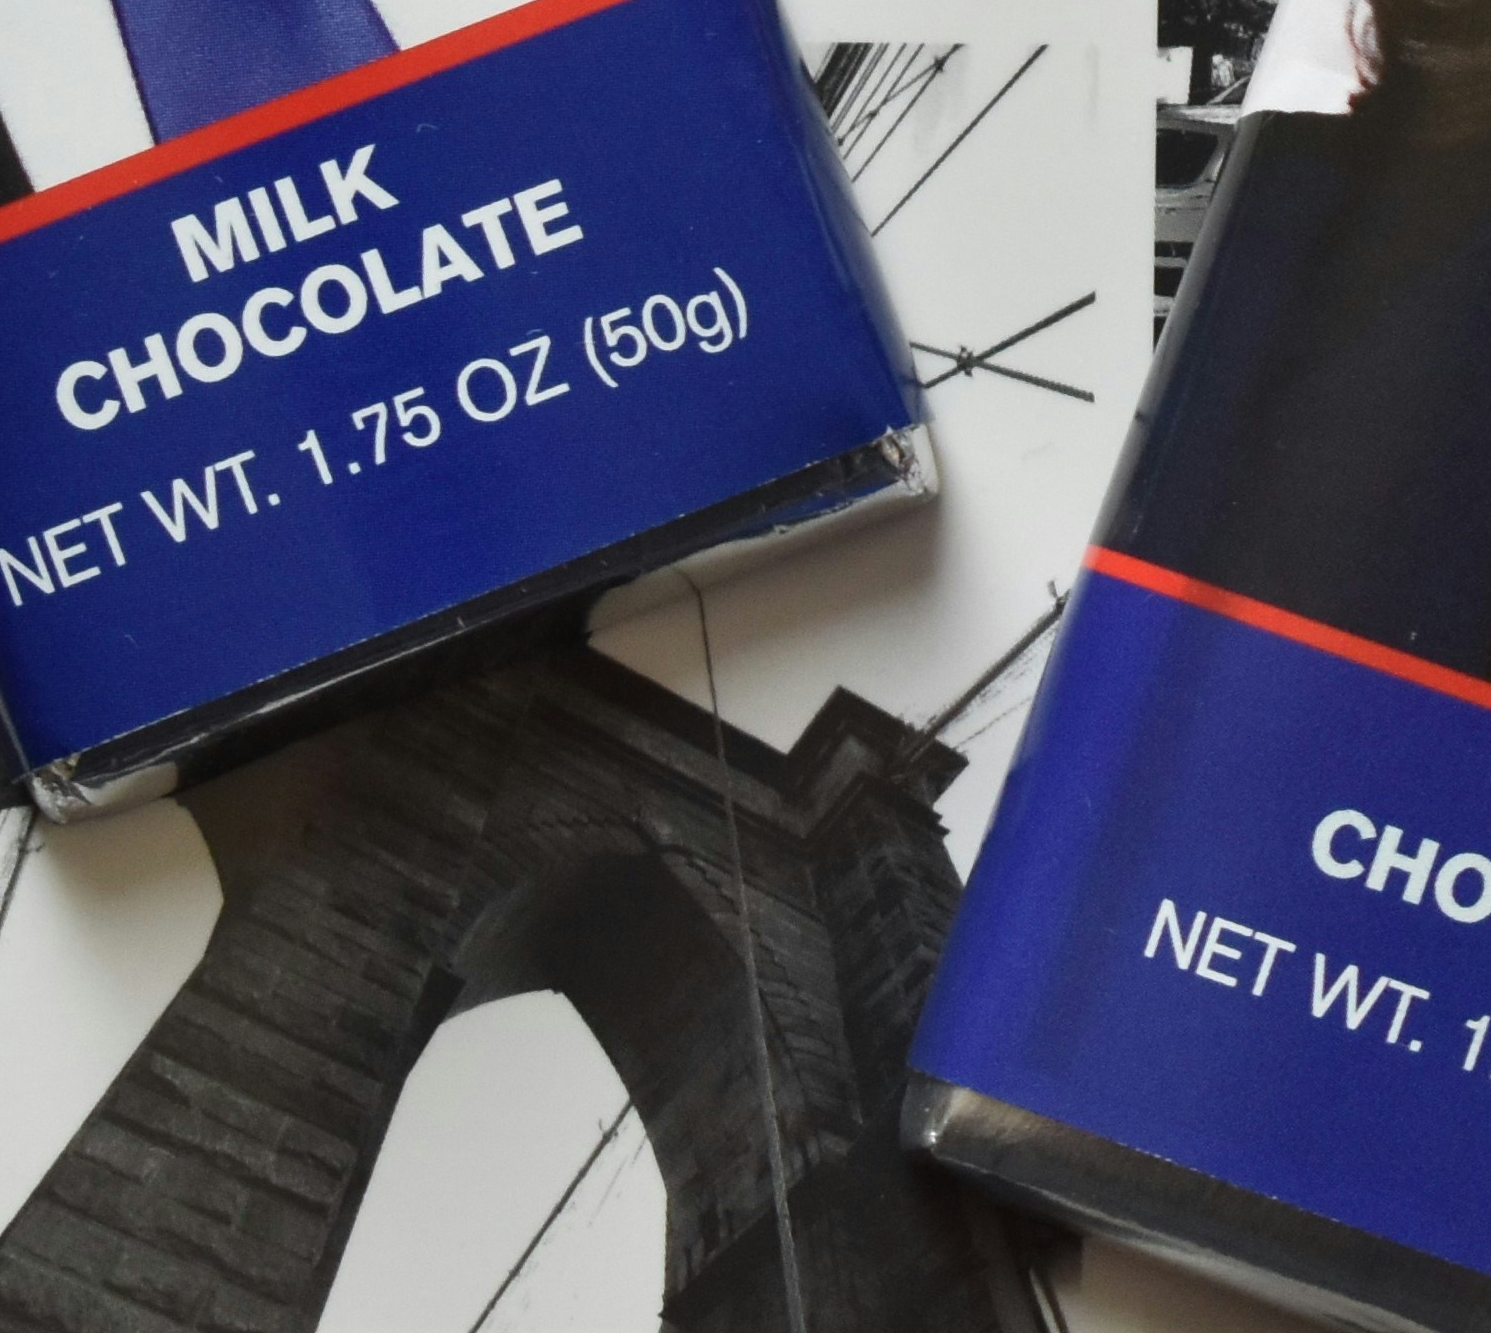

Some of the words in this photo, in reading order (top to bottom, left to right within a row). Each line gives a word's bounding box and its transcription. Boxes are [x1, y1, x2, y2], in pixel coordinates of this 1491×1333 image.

[56, 179, 583, 429] CHOCOLATE
[171, 145, 398, 282] MILK
[141, 451, 280, 542] WT.
[299, 387, 440, 484] 1.75
[457, 336, 569, 421] OZ
[584, 268, 747, 387] (50g)
[1144, 899, 1296, 996] NET
[1312, 953, 1430, 1051] WT.
